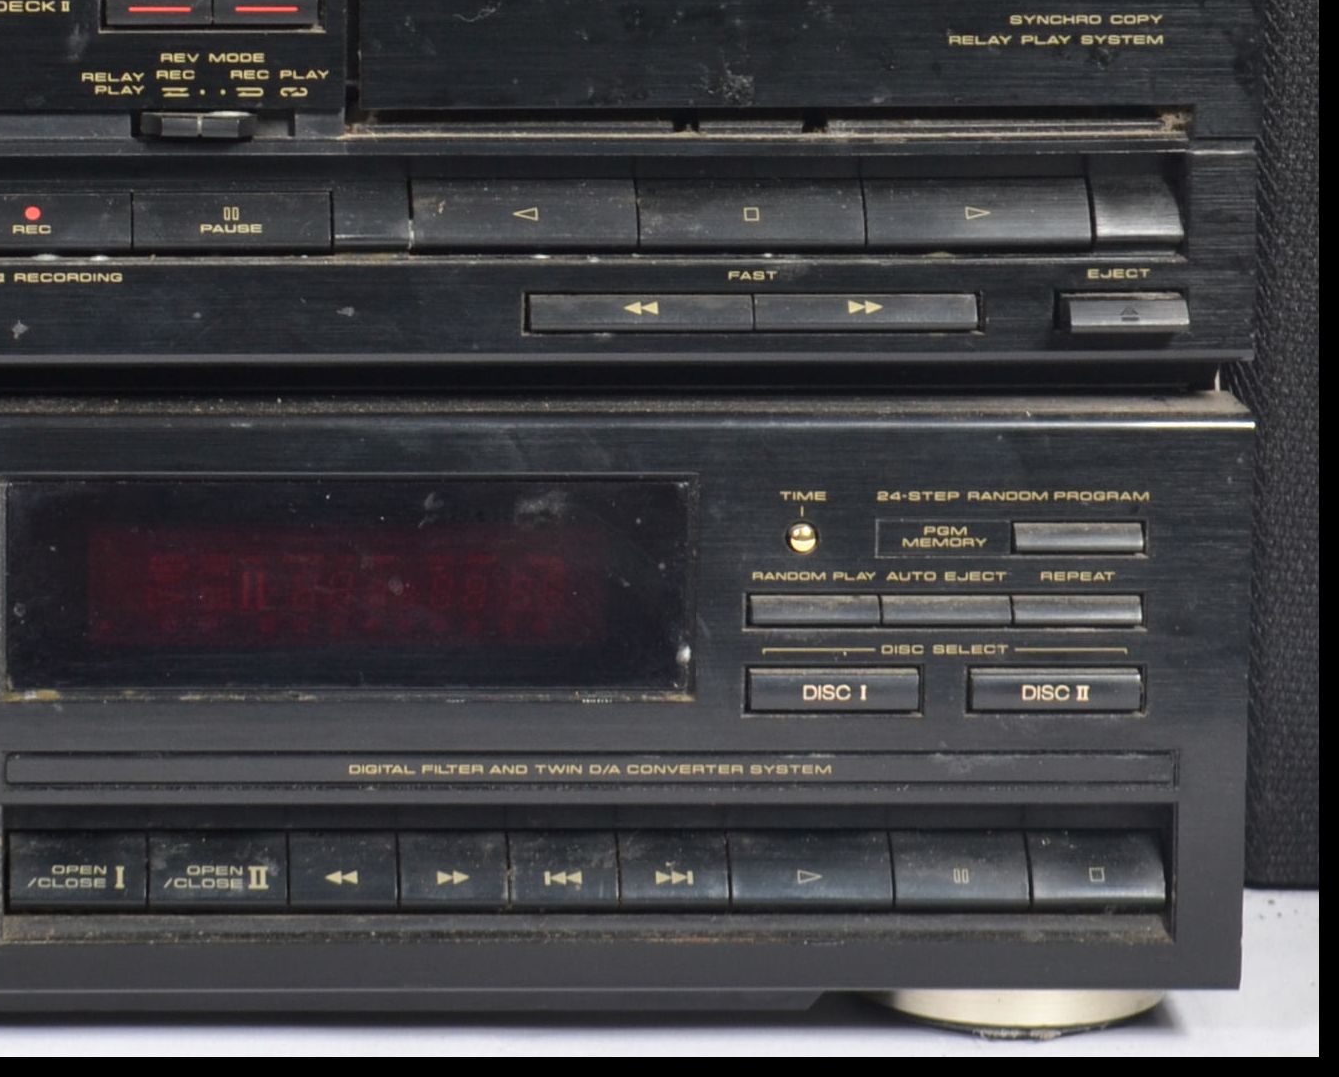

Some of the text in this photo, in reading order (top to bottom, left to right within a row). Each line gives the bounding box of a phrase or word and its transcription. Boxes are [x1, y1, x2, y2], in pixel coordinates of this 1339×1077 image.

[1010, 15, 1162, 25] SYNCHRO COPY
[949, 35, 1163, 45] RELAY PLAY SYSTEM
[161, 53, 264, 63] REV MODE
[82, 72, 144, 82] RELAY
[156, 70, 195, 80] REC
[231, 70, 269, 79] REC
[280, 70, 328, 79] PLAY
[95, 85, 144, 95] PLAY
[13, 225, 51, 234] REC
[200, 224, 262, 233] PAUSE
[14, 273, 122, 282] RECORDING
[728, 271, 777, 280] FAST
[1087, 269, 1150, 279] EJECT
[780, 491, 826, 501] TIME
[877, 491, 1149, 501] 24-STEP RANDOM PROGRAM
[924, 526, 967, 536] PGM
[902, 538, 986, 547] MEMORY
[752, 572, 875, 581] RANDOM PLAY
[887, 571, 1007, 581] AUTO EJECT
[1041, 572, 1115, 581] REPEAT
[881, 644, 1008, 655] DISC SELECT
[803, 684, 851, 700] DISC
[1022, 685, 1069, 701] DISC
[348, 764, 831, 775] DIGITAL FILTER AND TWIN D/A CONVERTER SYSTEM
[52, 865, 107, 875] OPEN
[187, 865, 243, 876] OPEN
[28, 877, 106, 889] /CLOSE
[164, 878, 243, 892] /CLOSE
